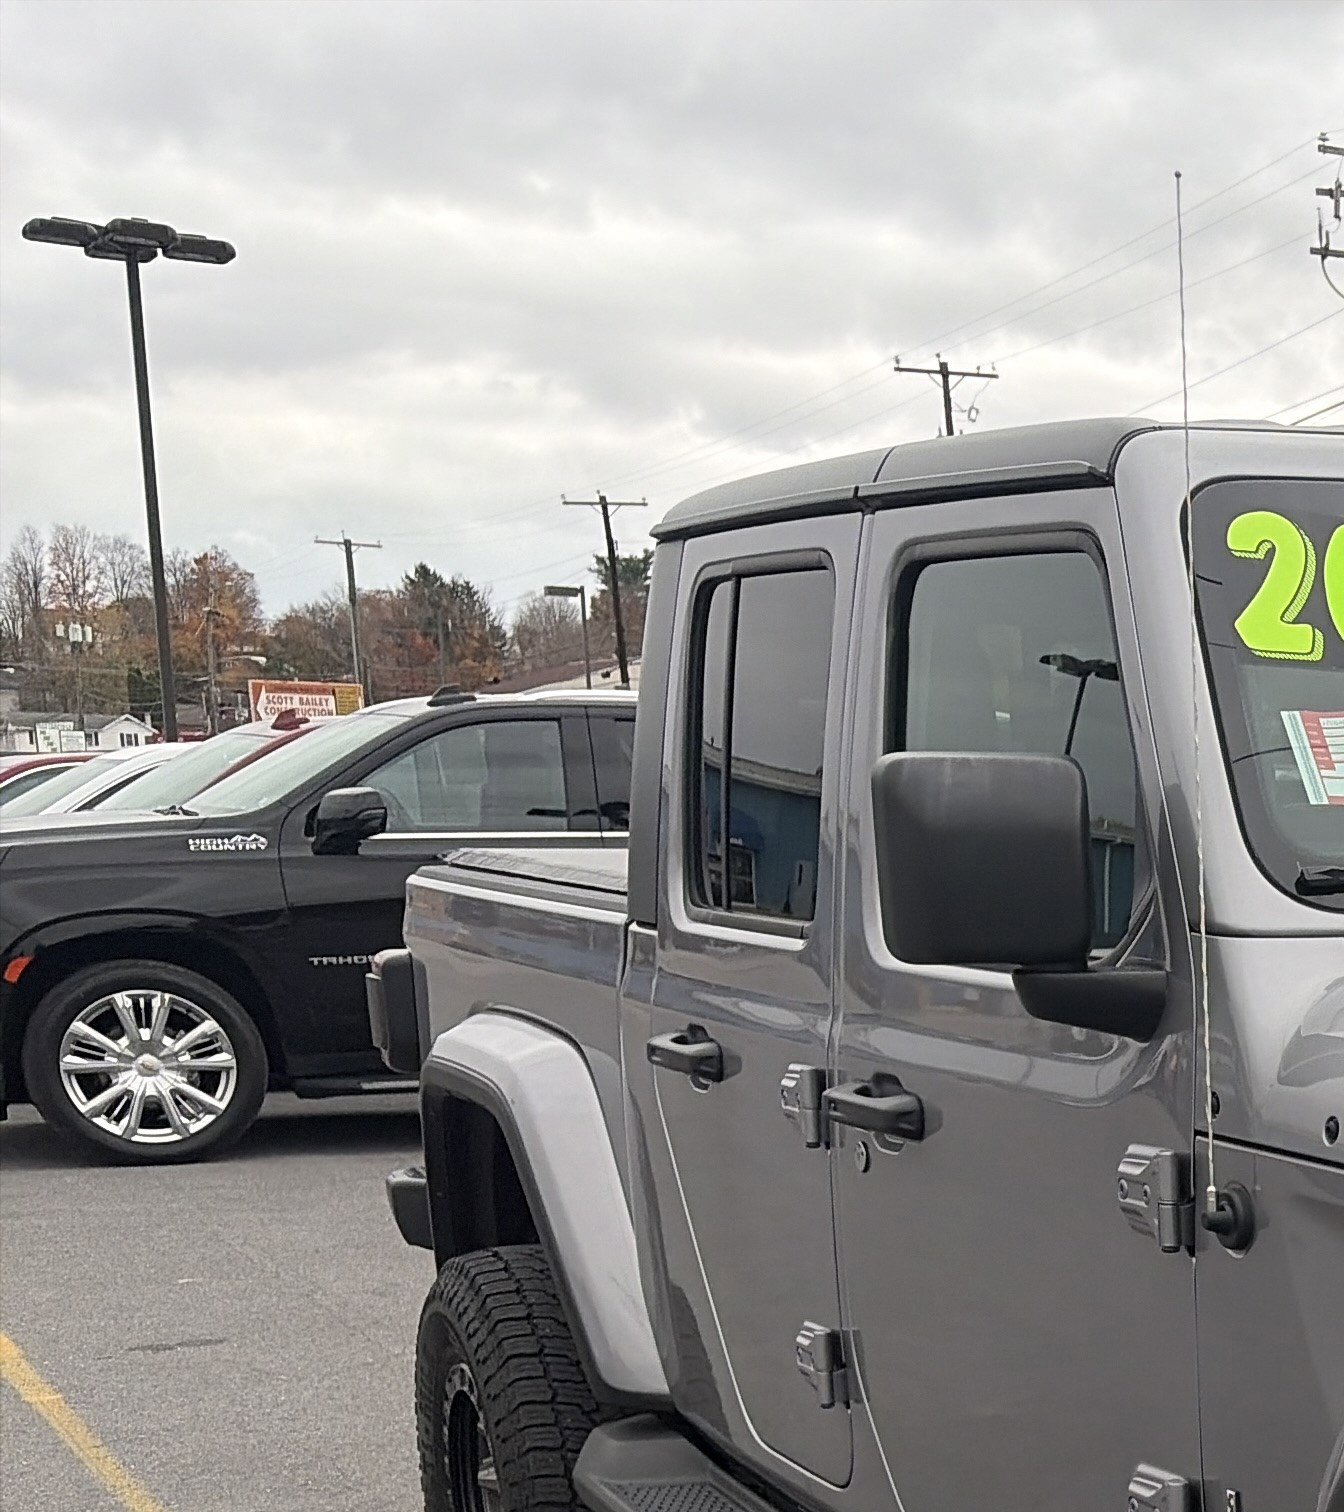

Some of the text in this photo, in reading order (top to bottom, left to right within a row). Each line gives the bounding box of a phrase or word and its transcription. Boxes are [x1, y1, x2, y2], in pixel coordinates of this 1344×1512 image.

[265, 695, 294, 706] SCOTT
[298, 696, 330, 707] BAILEY
[264, 706, 334, 718] CONRUCTION
